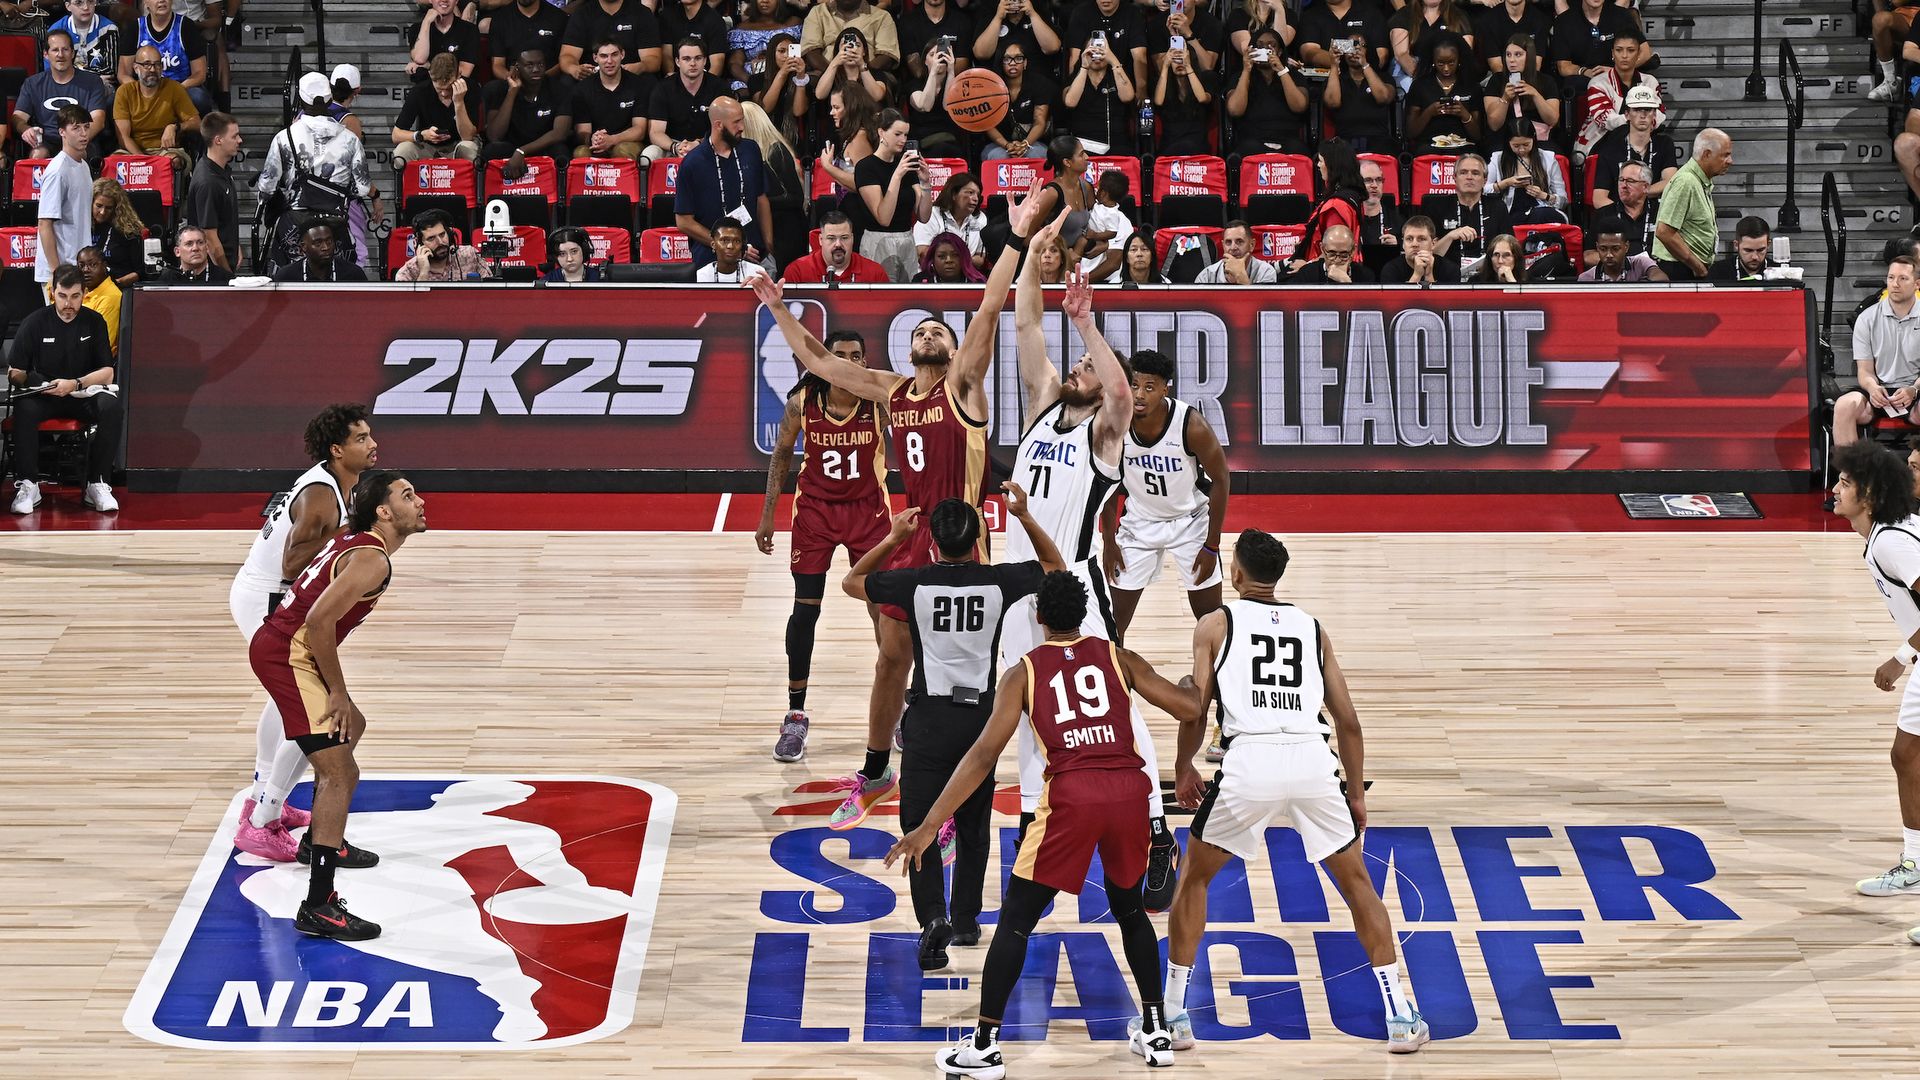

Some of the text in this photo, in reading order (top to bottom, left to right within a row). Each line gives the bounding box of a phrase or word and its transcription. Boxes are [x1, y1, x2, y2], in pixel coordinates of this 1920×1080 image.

[1820, 19, 1843, 31] FF
[254, 28, 274, 40] FF
[238, 87, 260, 99] EE
[1835, 81, 1857, 93] EE
[951, 101, 993, 117] Wilson
[1857, 145, 1882, 157] DD
[130, 166, 153, 175] SUMMER
[432, 170, 455, 178] SUMMER
[598, 168, 621, 177] SUMMER
[1184, 165, 1207, 175] SUMMER
[1271, 167, 1295, 176] SUMMER
[130, 175, 149, 184] LEAGUE
[432, 179, 451, 188] LEAGUE
[598, 178, 617, 186] LEAGUE
[1184, 174, 1204, 183] LEAGUE
[1271, 176, 1291, 185] LEAGUE
[1873, 210, 1900, 223] CC
[372, 338, 703, 415] 2K25
[1257, 309, 1548, 447] LEAGUE
[890, 405, 944, 428] CLEVELAND
[810, 430, 873, 447] CLEVELAND
[906, 431, 926, 473] 8
[822, 450, 861, 481] 21
[1125, 454, 1183, 473] MAGIC
[1028, 465, 1052, 499] 71
[1144, 471, 1168, 497] 51
[932, 595, 985, 633] 216
[1250, 633, 1303, 688] 23
[1048, 664, 1112, 725] 19
[1251, 689, 1302, 711] DA SILVA
[1062, 724, 1116, 749] SMITH
[206, 980, 434, 1028] NBA
